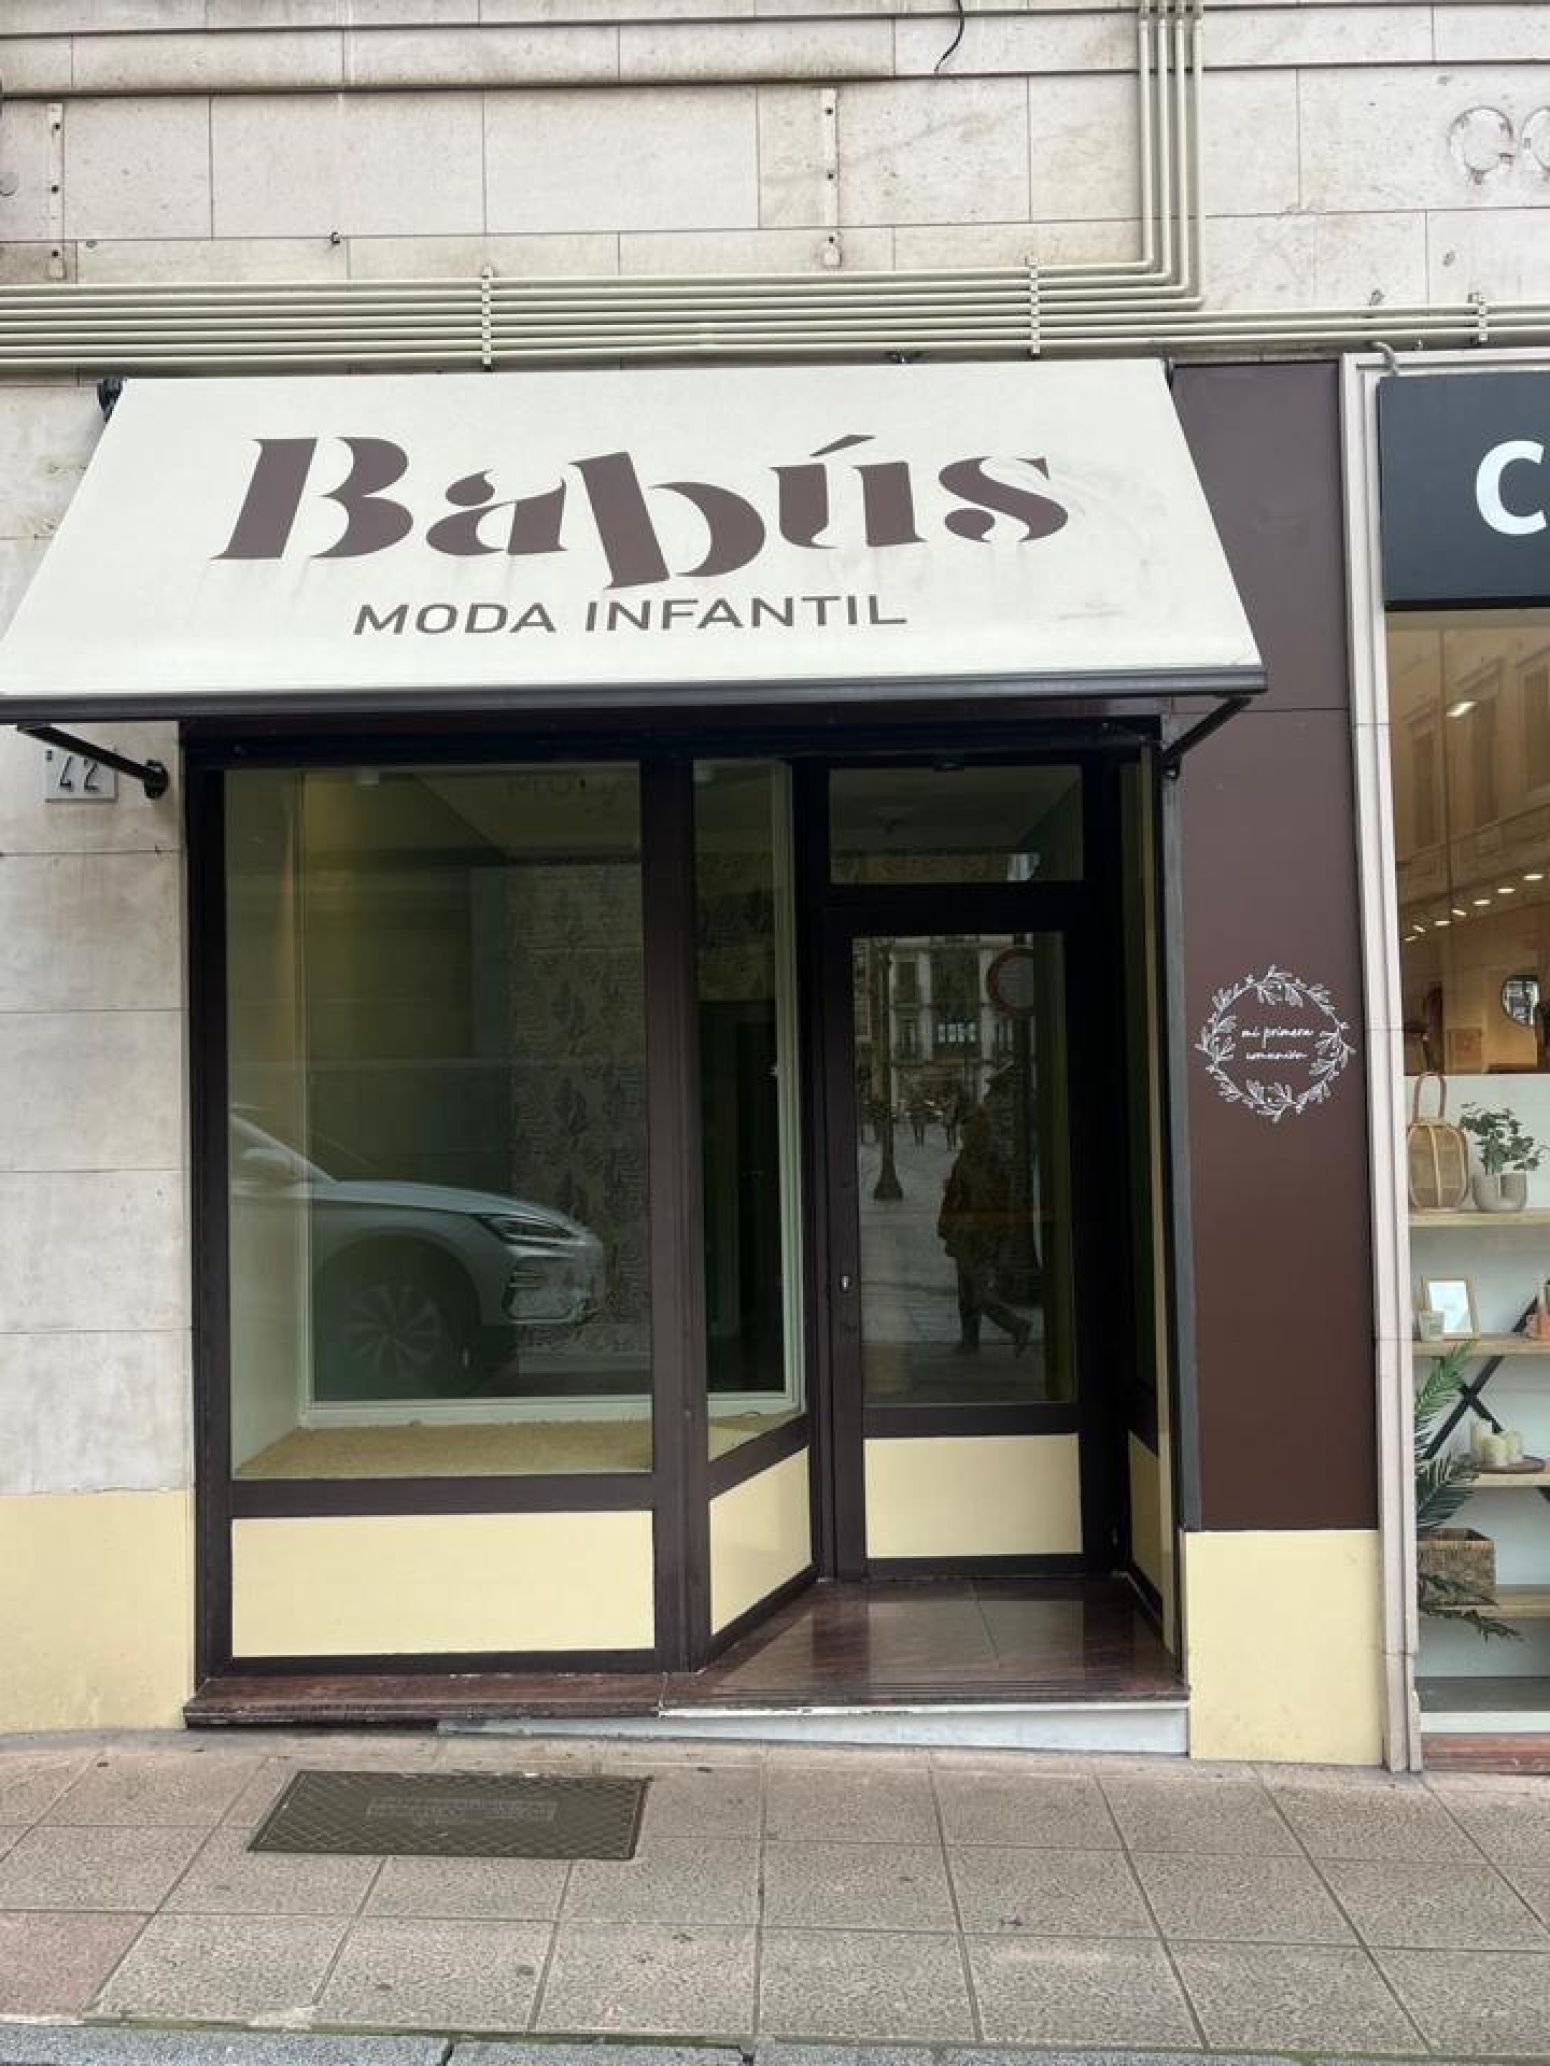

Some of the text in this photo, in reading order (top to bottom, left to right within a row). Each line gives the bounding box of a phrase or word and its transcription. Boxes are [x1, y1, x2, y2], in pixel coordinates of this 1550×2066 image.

[213, 433, 1070, 589] Babús
[1476, 440, 1547, 536] C
[353, 595, 907, 635] MODA INFANTIL
